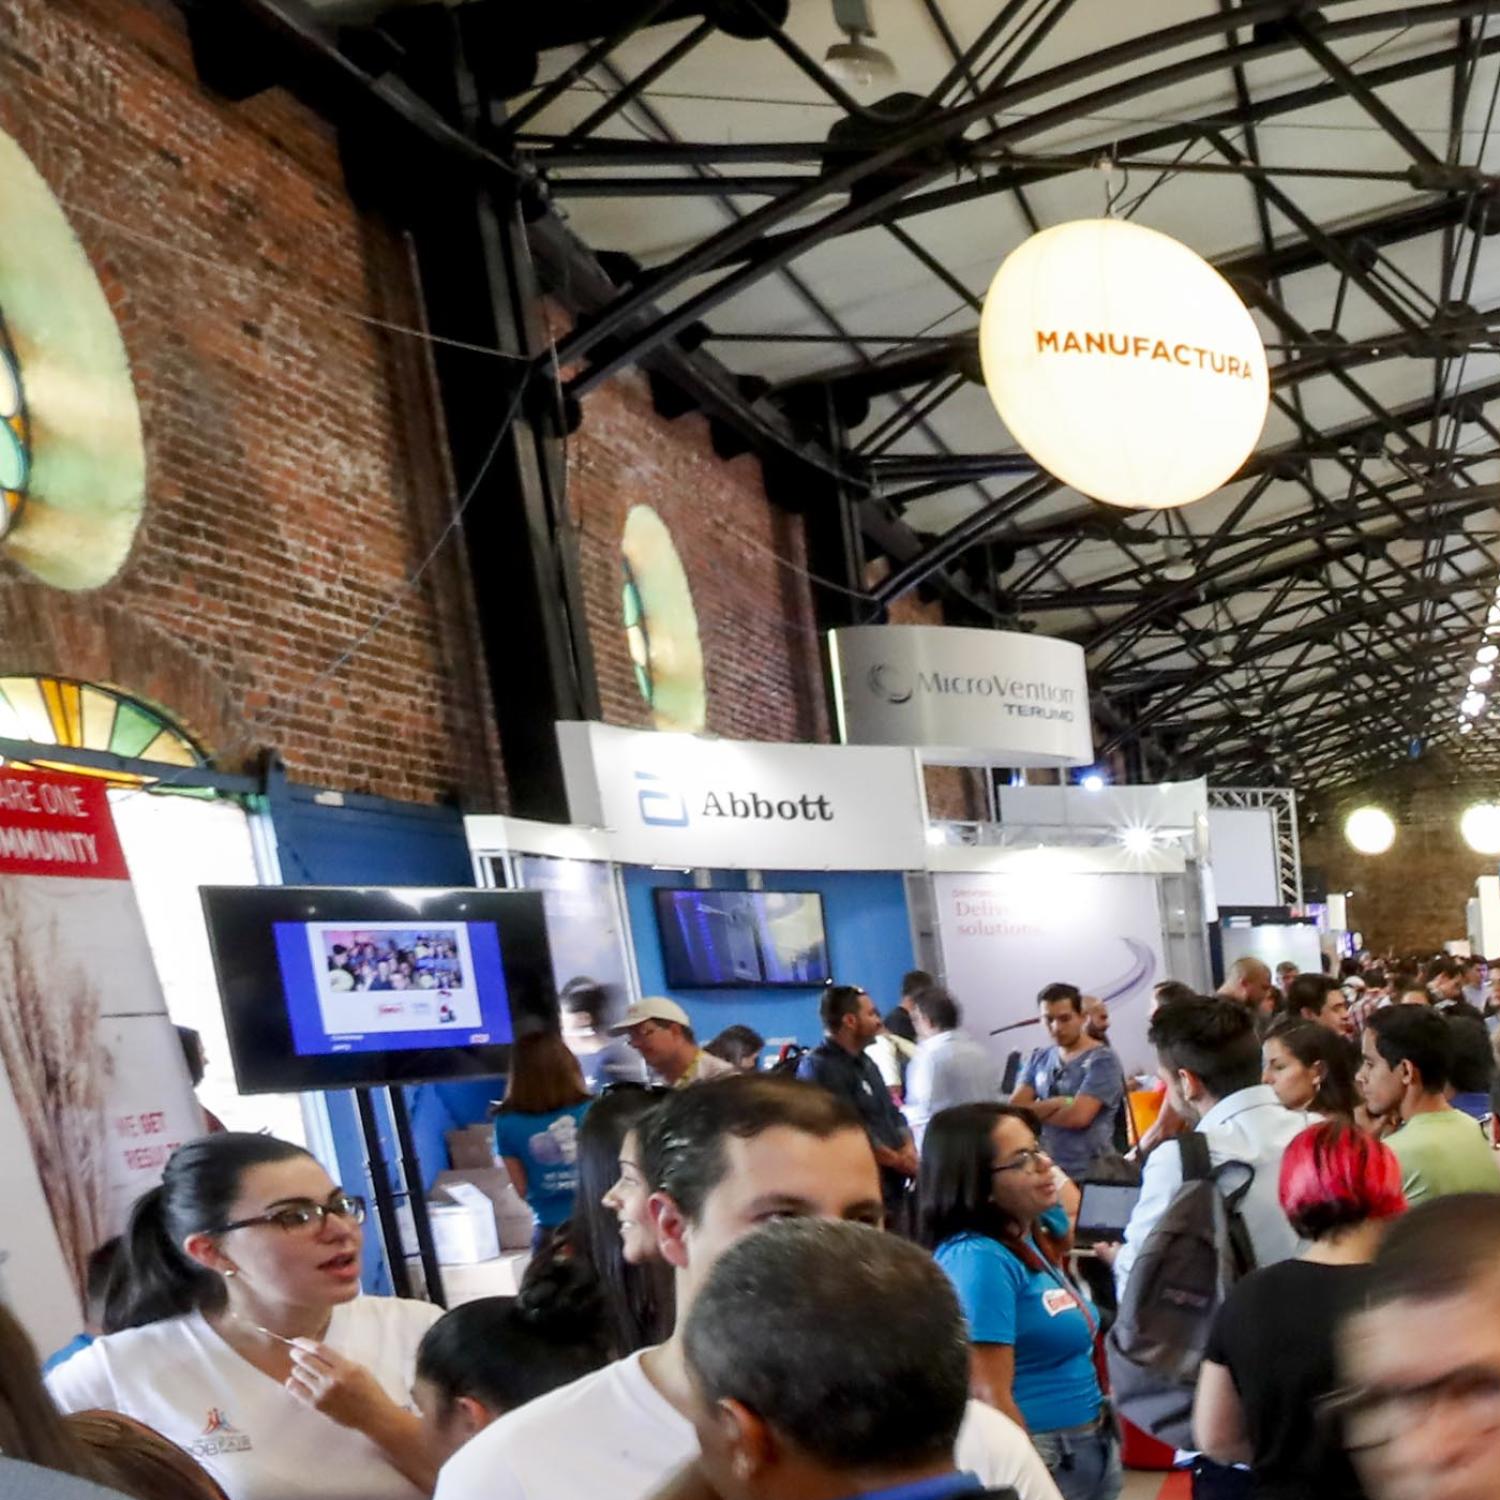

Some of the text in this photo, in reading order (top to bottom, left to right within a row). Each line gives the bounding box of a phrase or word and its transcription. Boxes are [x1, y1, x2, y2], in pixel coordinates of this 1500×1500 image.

[1036, 330, 1252, 380] MANUFACTURA
[40, 783, 90, 817] ONE
[701, 790, 835, 822] Abbott
